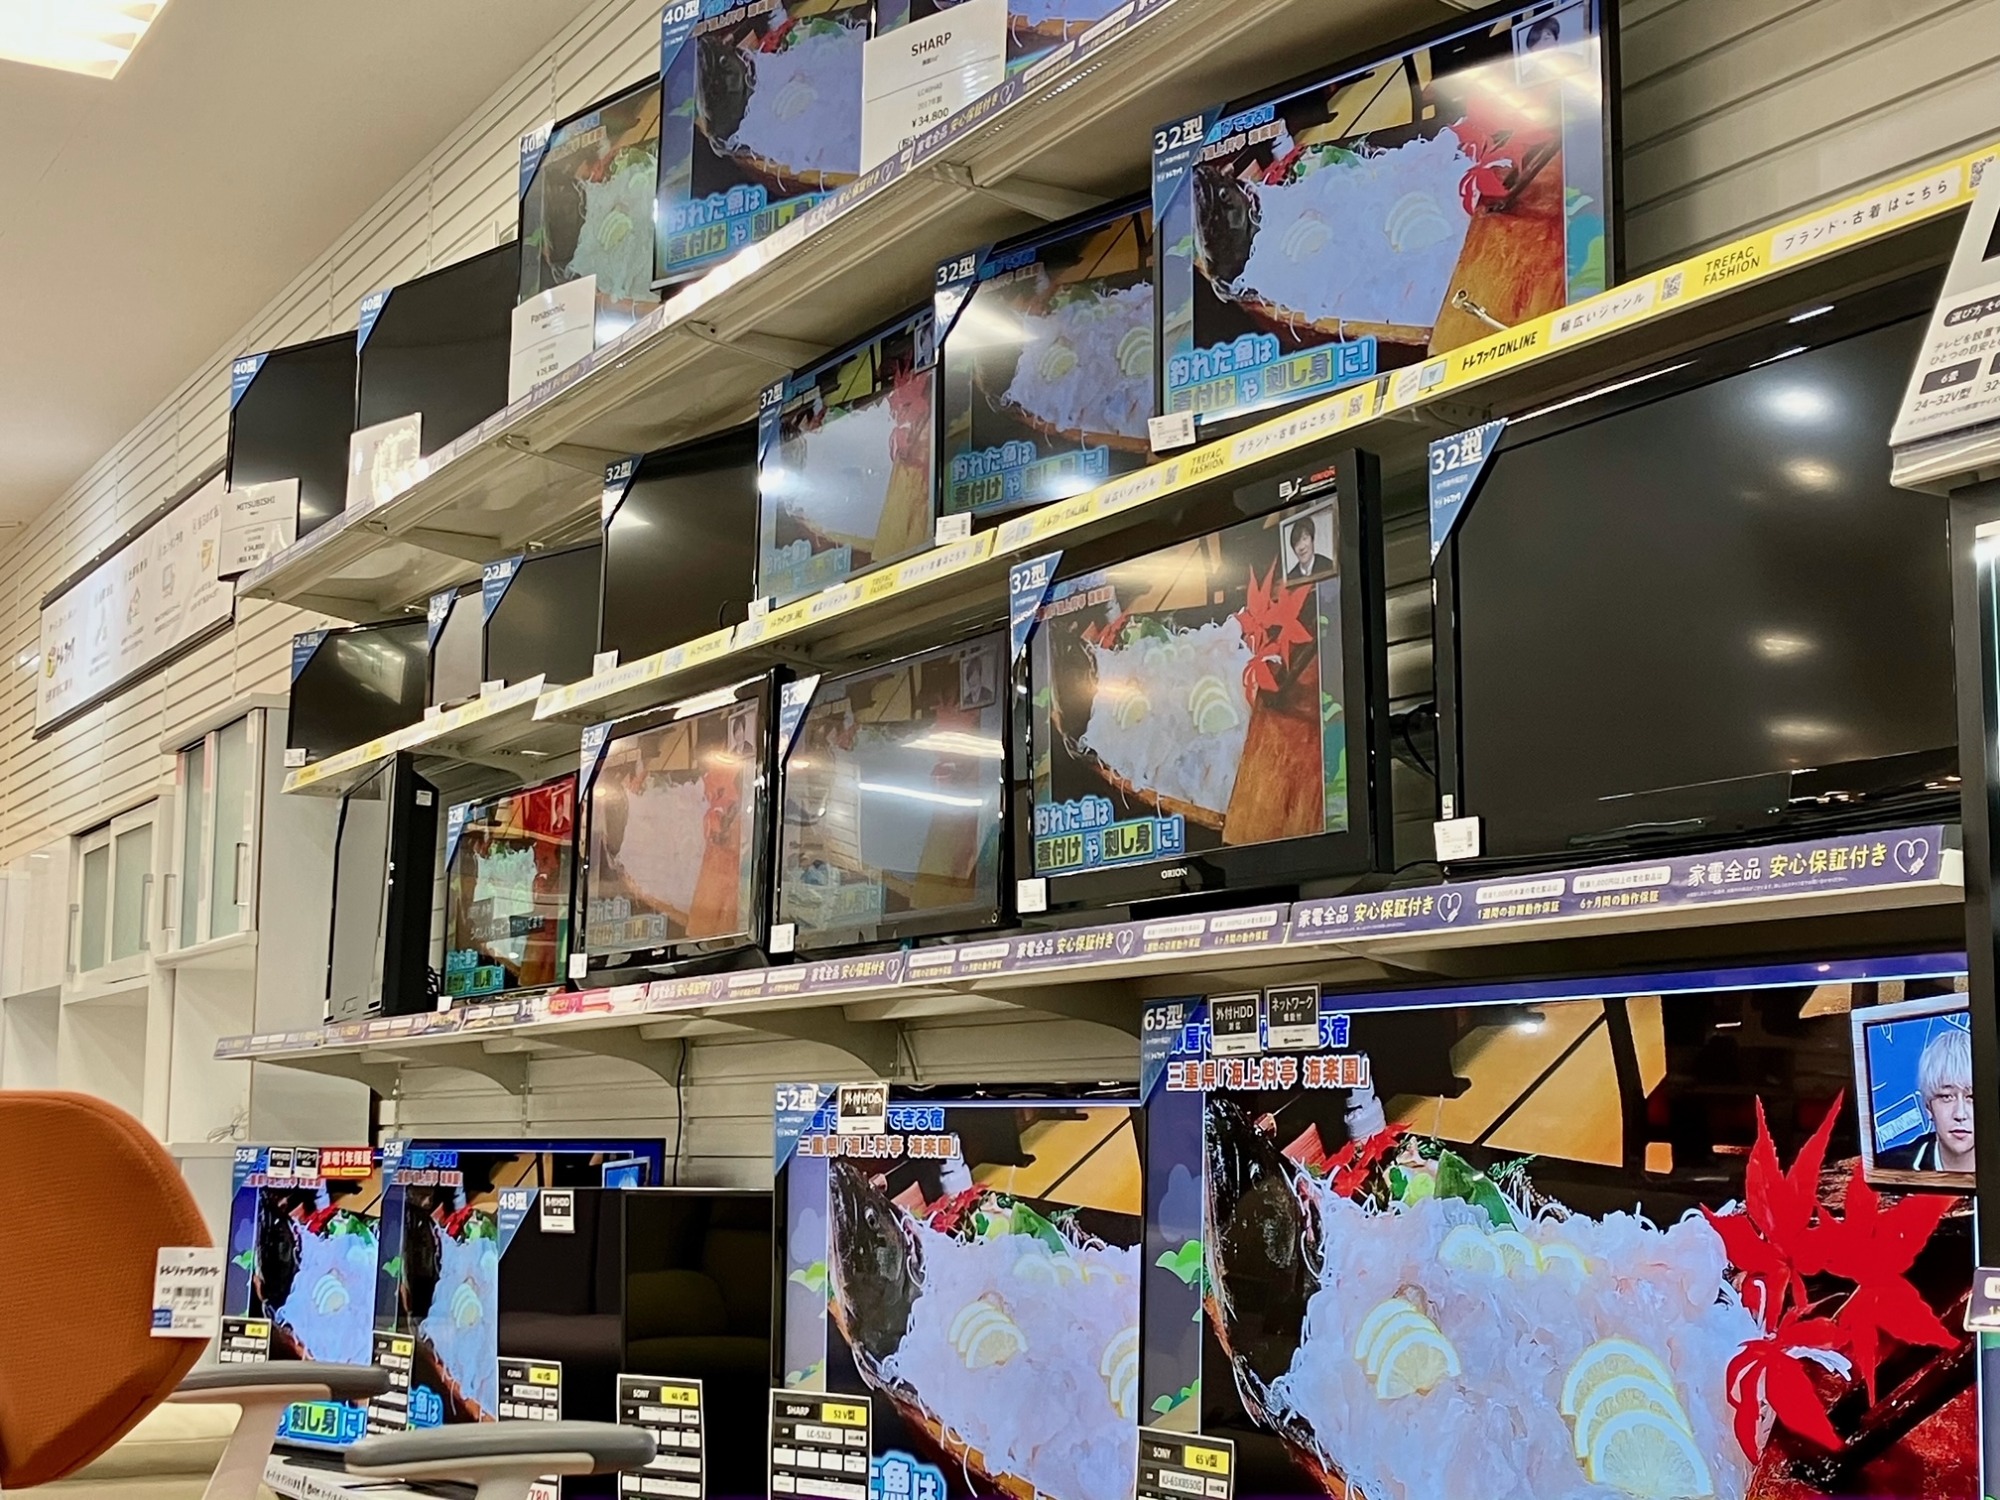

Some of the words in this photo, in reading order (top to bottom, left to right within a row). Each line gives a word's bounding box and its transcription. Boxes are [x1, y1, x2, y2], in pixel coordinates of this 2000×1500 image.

[663, 1, 699, 25] 40型
[911, 32, 952, 56] SHARP
[1155, 114, 1204, 154] 32型
[937, 254, 976, 286] 32型
[1705, 244, 1754, 273] TREFAC
[1702, 256, 1761, 287] FASHION
[530, 302, 566, 324] Panasonic
[1559, 292, 1646, 334] 幅広いジャンル
[1950, 305, 1983, 323] 選び方
[1169, 337, 1274, 387] 釣れた魚は
[760, 382, 784, 409] 32型
[1192, 448, 1222, 465] TREFAC
[1431, 430, 1482, 475] 32型
[605, 460, 632, 482] 32型
[1190, 456, 1224, 477] FASHION
[237, 496, 276, 511] MITSUBISHI
[1011, 562, 1046, 594] 32型
[1035, 798, 1111, 837] 釣れた魚は
[1161, 867, 1188, 879] ORION
[1687, 856, 1762, 887] 家電全品
[1769, 842, 1888, 879] 安心保証付き
[1298, 904, 1349, 930] 家電全品
[1353, 896, 1434, 923] 安心保証付き
[1016, 939, 1054, 960] 家電全品
[1057, 932, 1115, 955] 安心保証付き
[1216, 1005, 1254, 1020] 外付HDD
[1271, 995, 1314, 1012] ネットワーク
[1144, 1003, 1184, 1031] 65型
[1167, 1056, 1298, 1091] 三重県「海上料亭
[1303, 1055, 1370, 1090] 海楽園」
[776, 1088, 817, 1111] 52型
[889, 1107, 945, 1131] できる宿
[797, 1135, 904, 1158] 三重県「海上料亭
[908, 1133, 961, 1158] 海楽園」
[633, 1389, 650, 1398] SONY
[786, 1405, 810, 1416] SHARP
[1153, 1447, 1172, 1459] SONY
